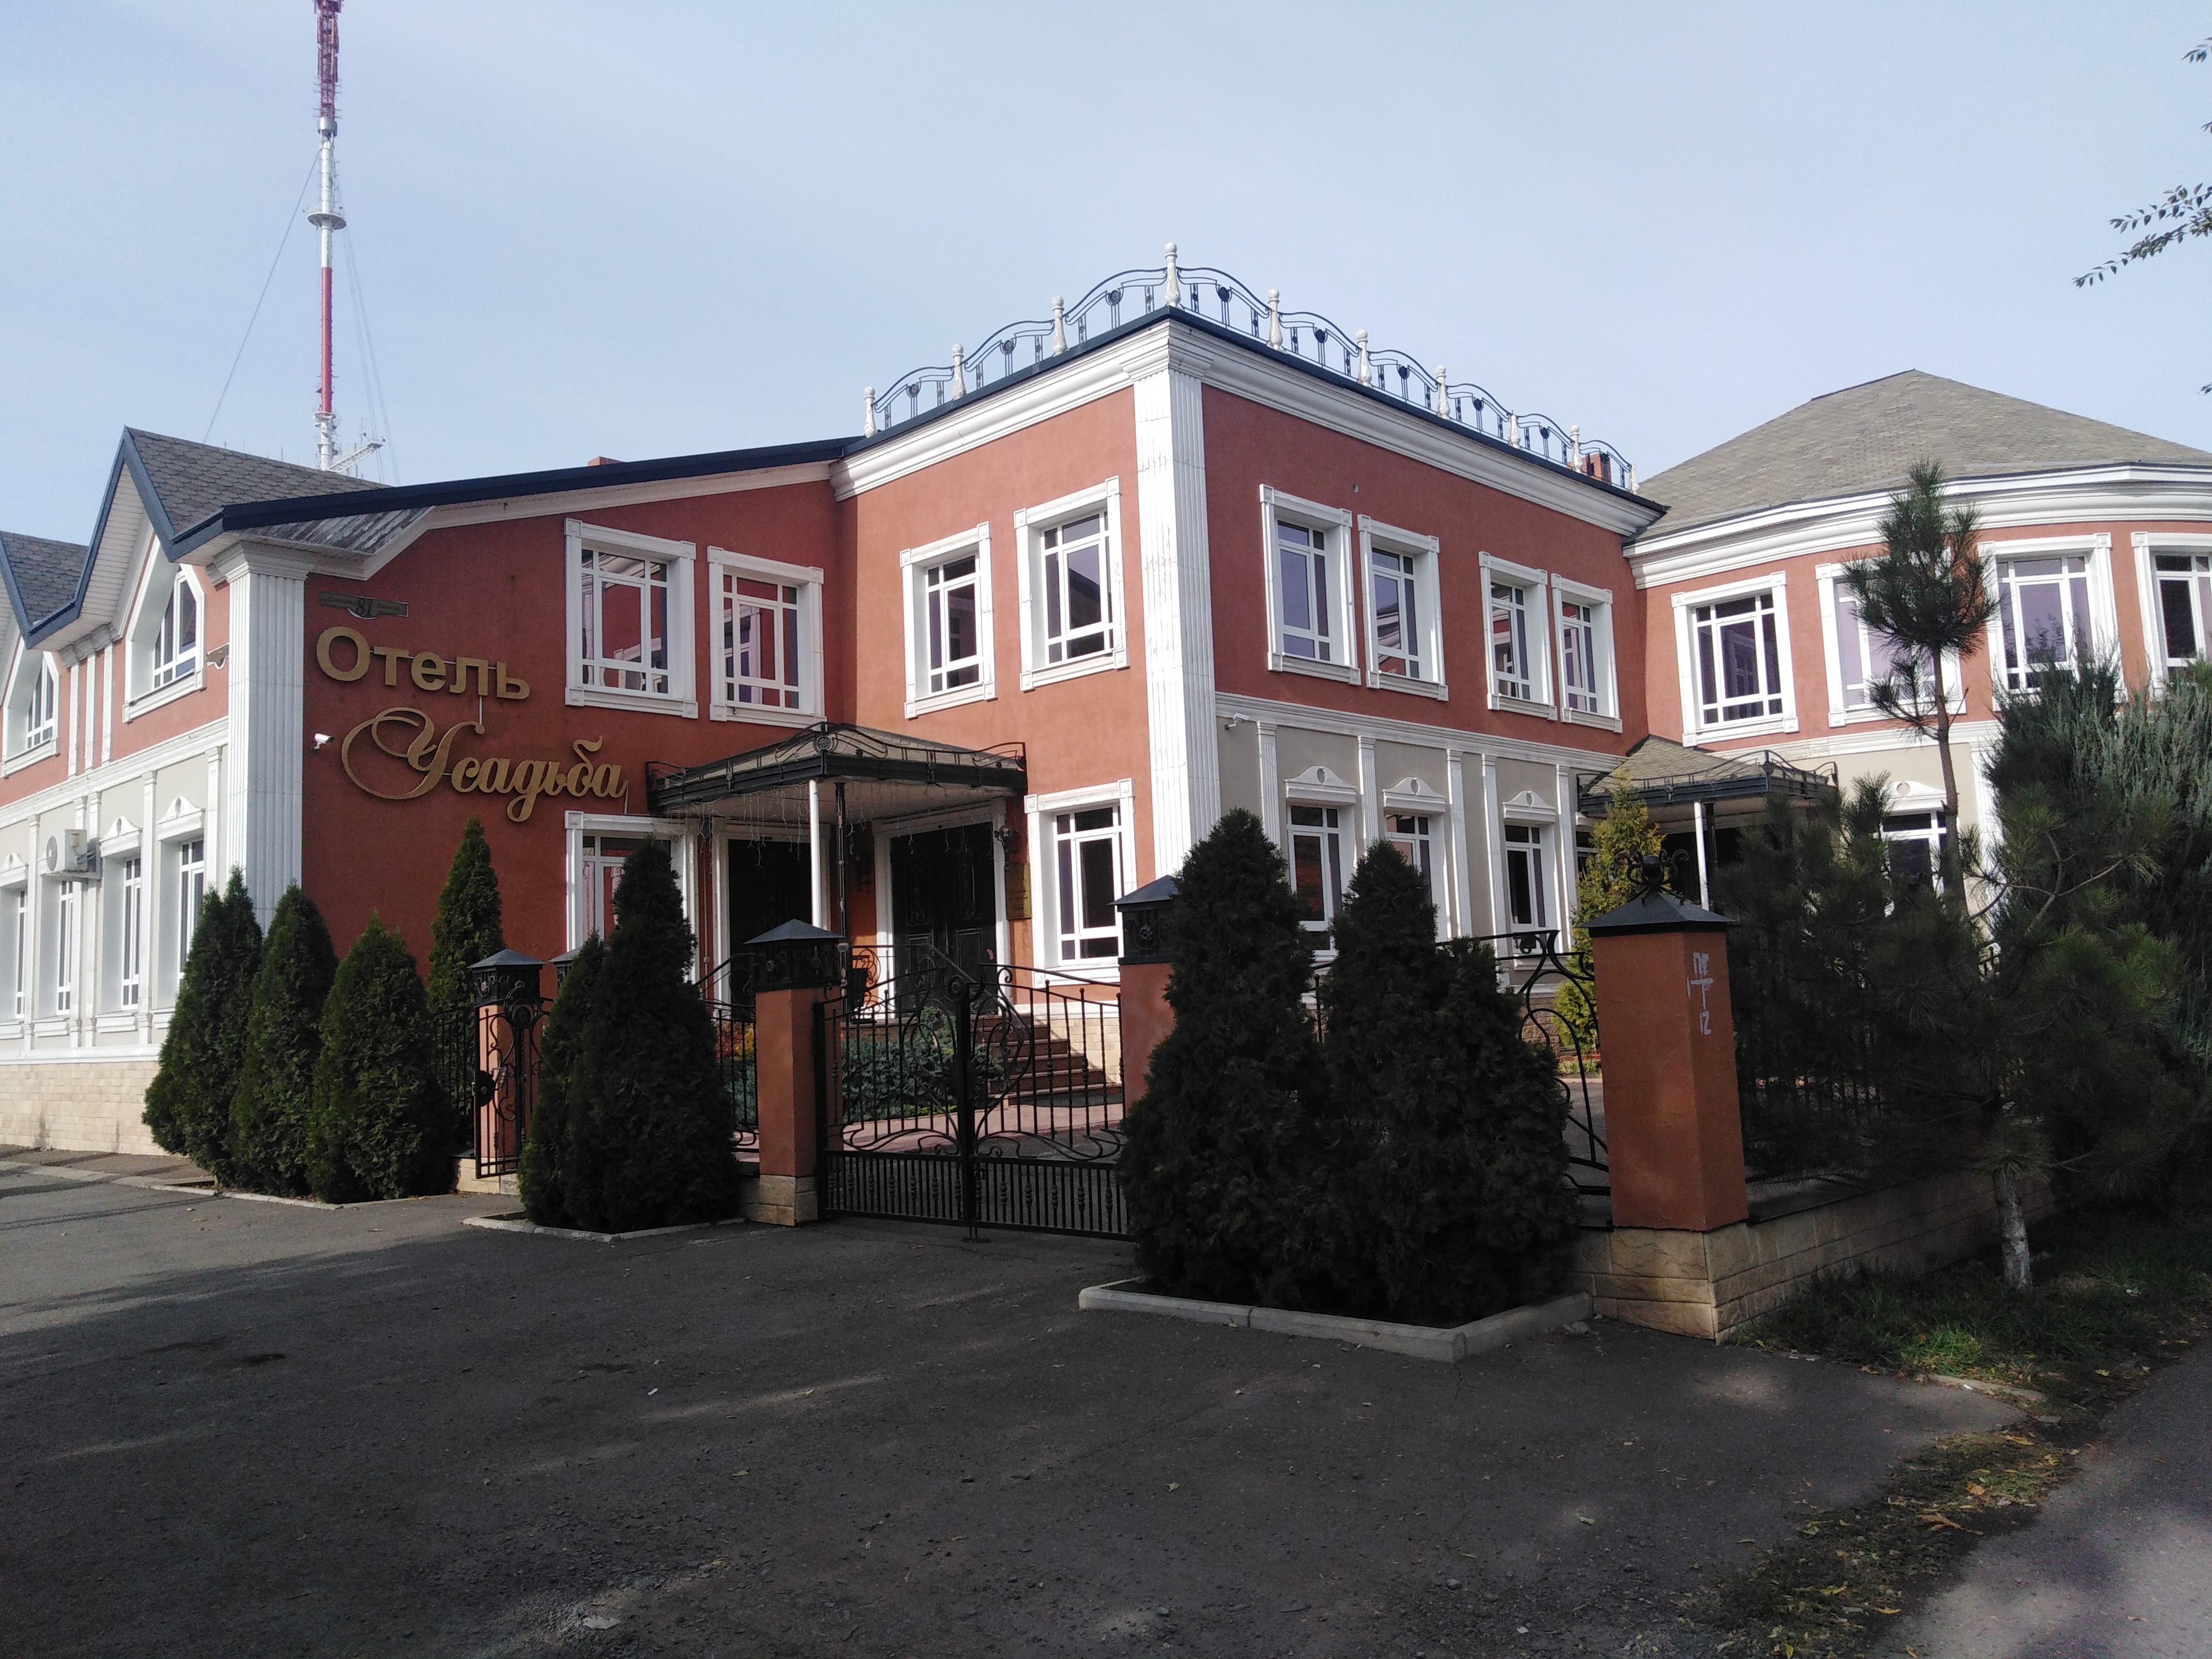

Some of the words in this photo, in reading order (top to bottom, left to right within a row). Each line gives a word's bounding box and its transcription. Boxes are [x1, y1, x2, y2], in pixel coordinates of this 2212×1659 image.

[356, 598, 373, 616] 81
[316, 626, 531, 700] Отель
[341, 707, 629, 823] Усадьба
